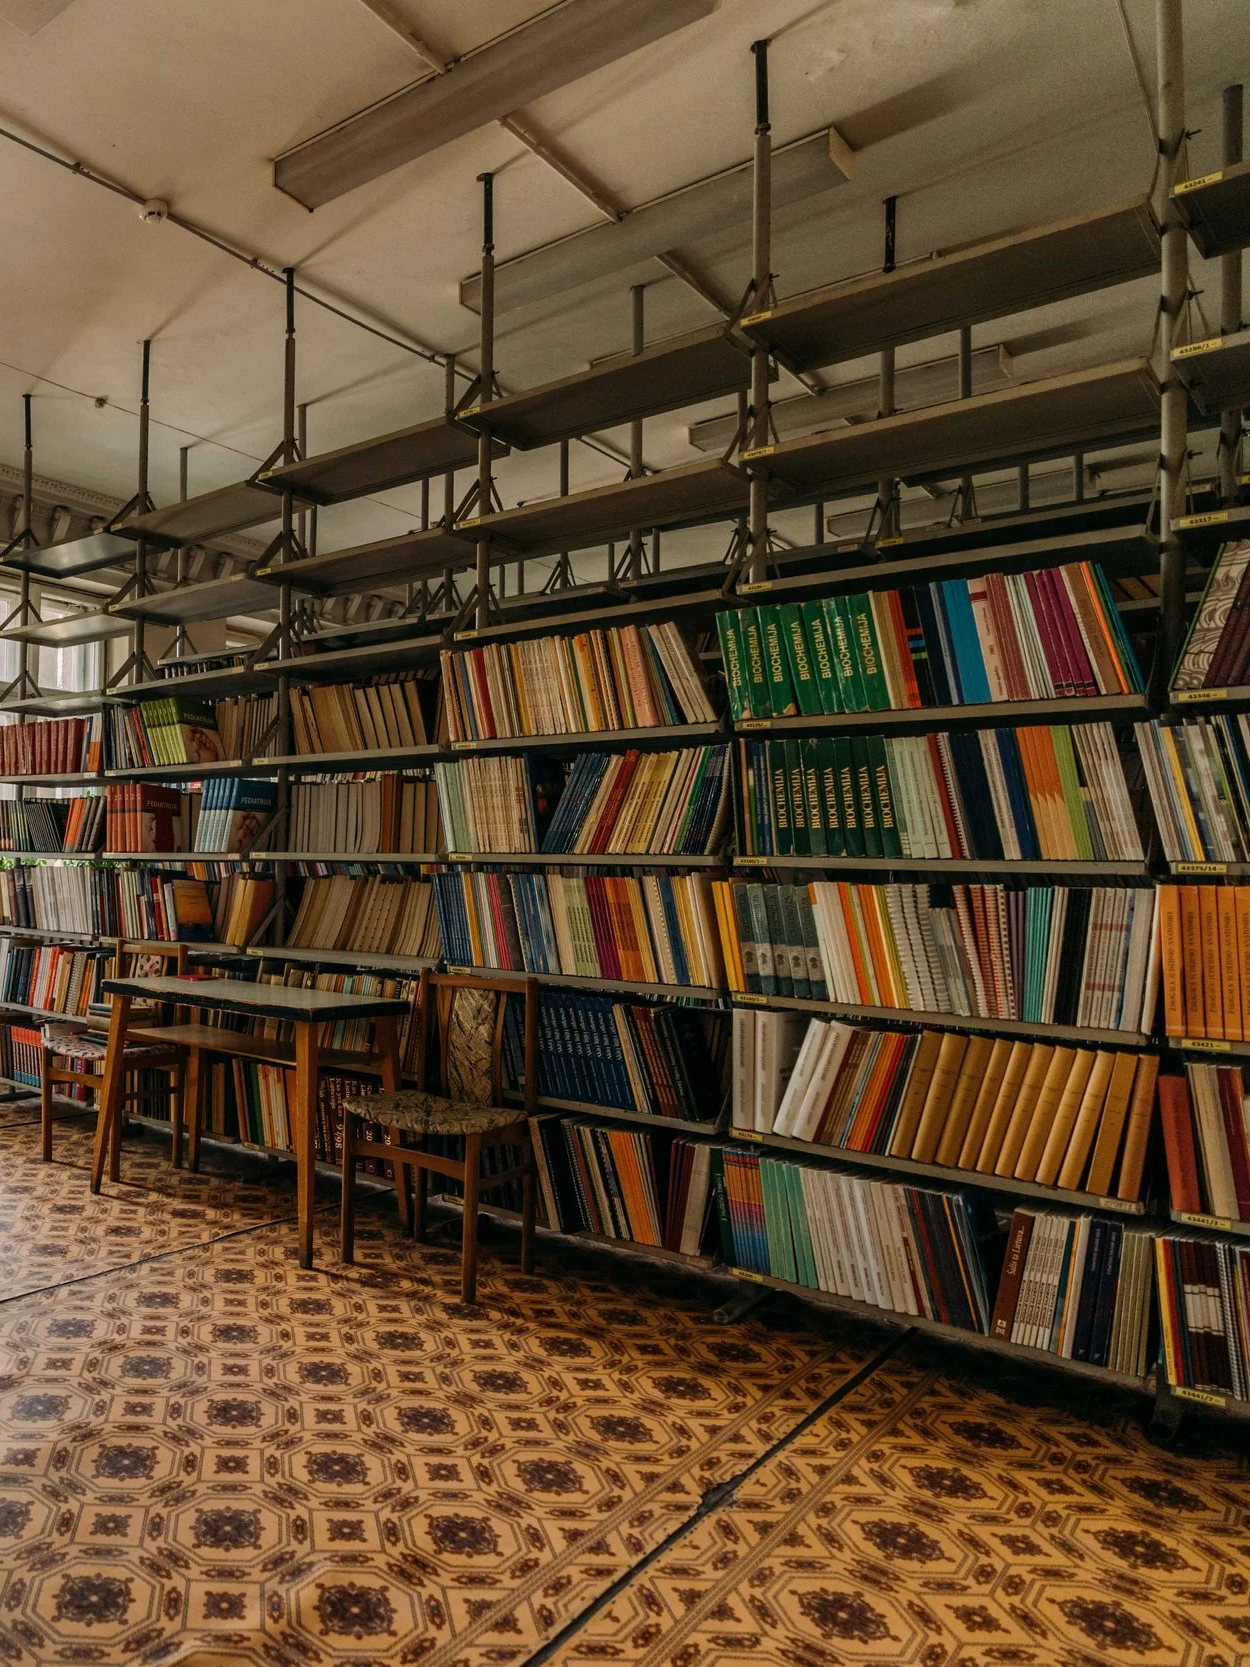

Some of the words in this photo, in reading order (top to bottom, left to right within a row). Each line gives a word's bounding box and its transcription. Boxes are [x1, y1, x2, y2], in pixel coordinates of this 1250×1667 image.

[729, 628, 742, 687] BIOCHEMIJA
[748, 625, 763, 684] BIOCHEMIJA
[767, 622, 784, 682] BIOCHEMIJA
[791, 620, 811, 681] BIOCHEMIJA
[811, 618, 832, 679] BIOCHEMIJA
[835, 615, 854, 677] BIOCHEMIJA
[857, 612, 877, 675] BIOCHEMIJA
[146, 800, 178, 811] PEDIATRIJA
[775, 768, 788, 829] BIOCHEMIJA
[792, 767, 805, 829] BIOCHEMIJA
[807, 767, 822, 829] BIOCHEMIJA
[824, 767, 839, 829] BIOCHEMIJA
[841, 766, 857, 829] BIOCHEMIJA
[858, 765, 876, 829] BIOCHEMIJA
[876, 764, 894, 829] BIOCHEMIJA
